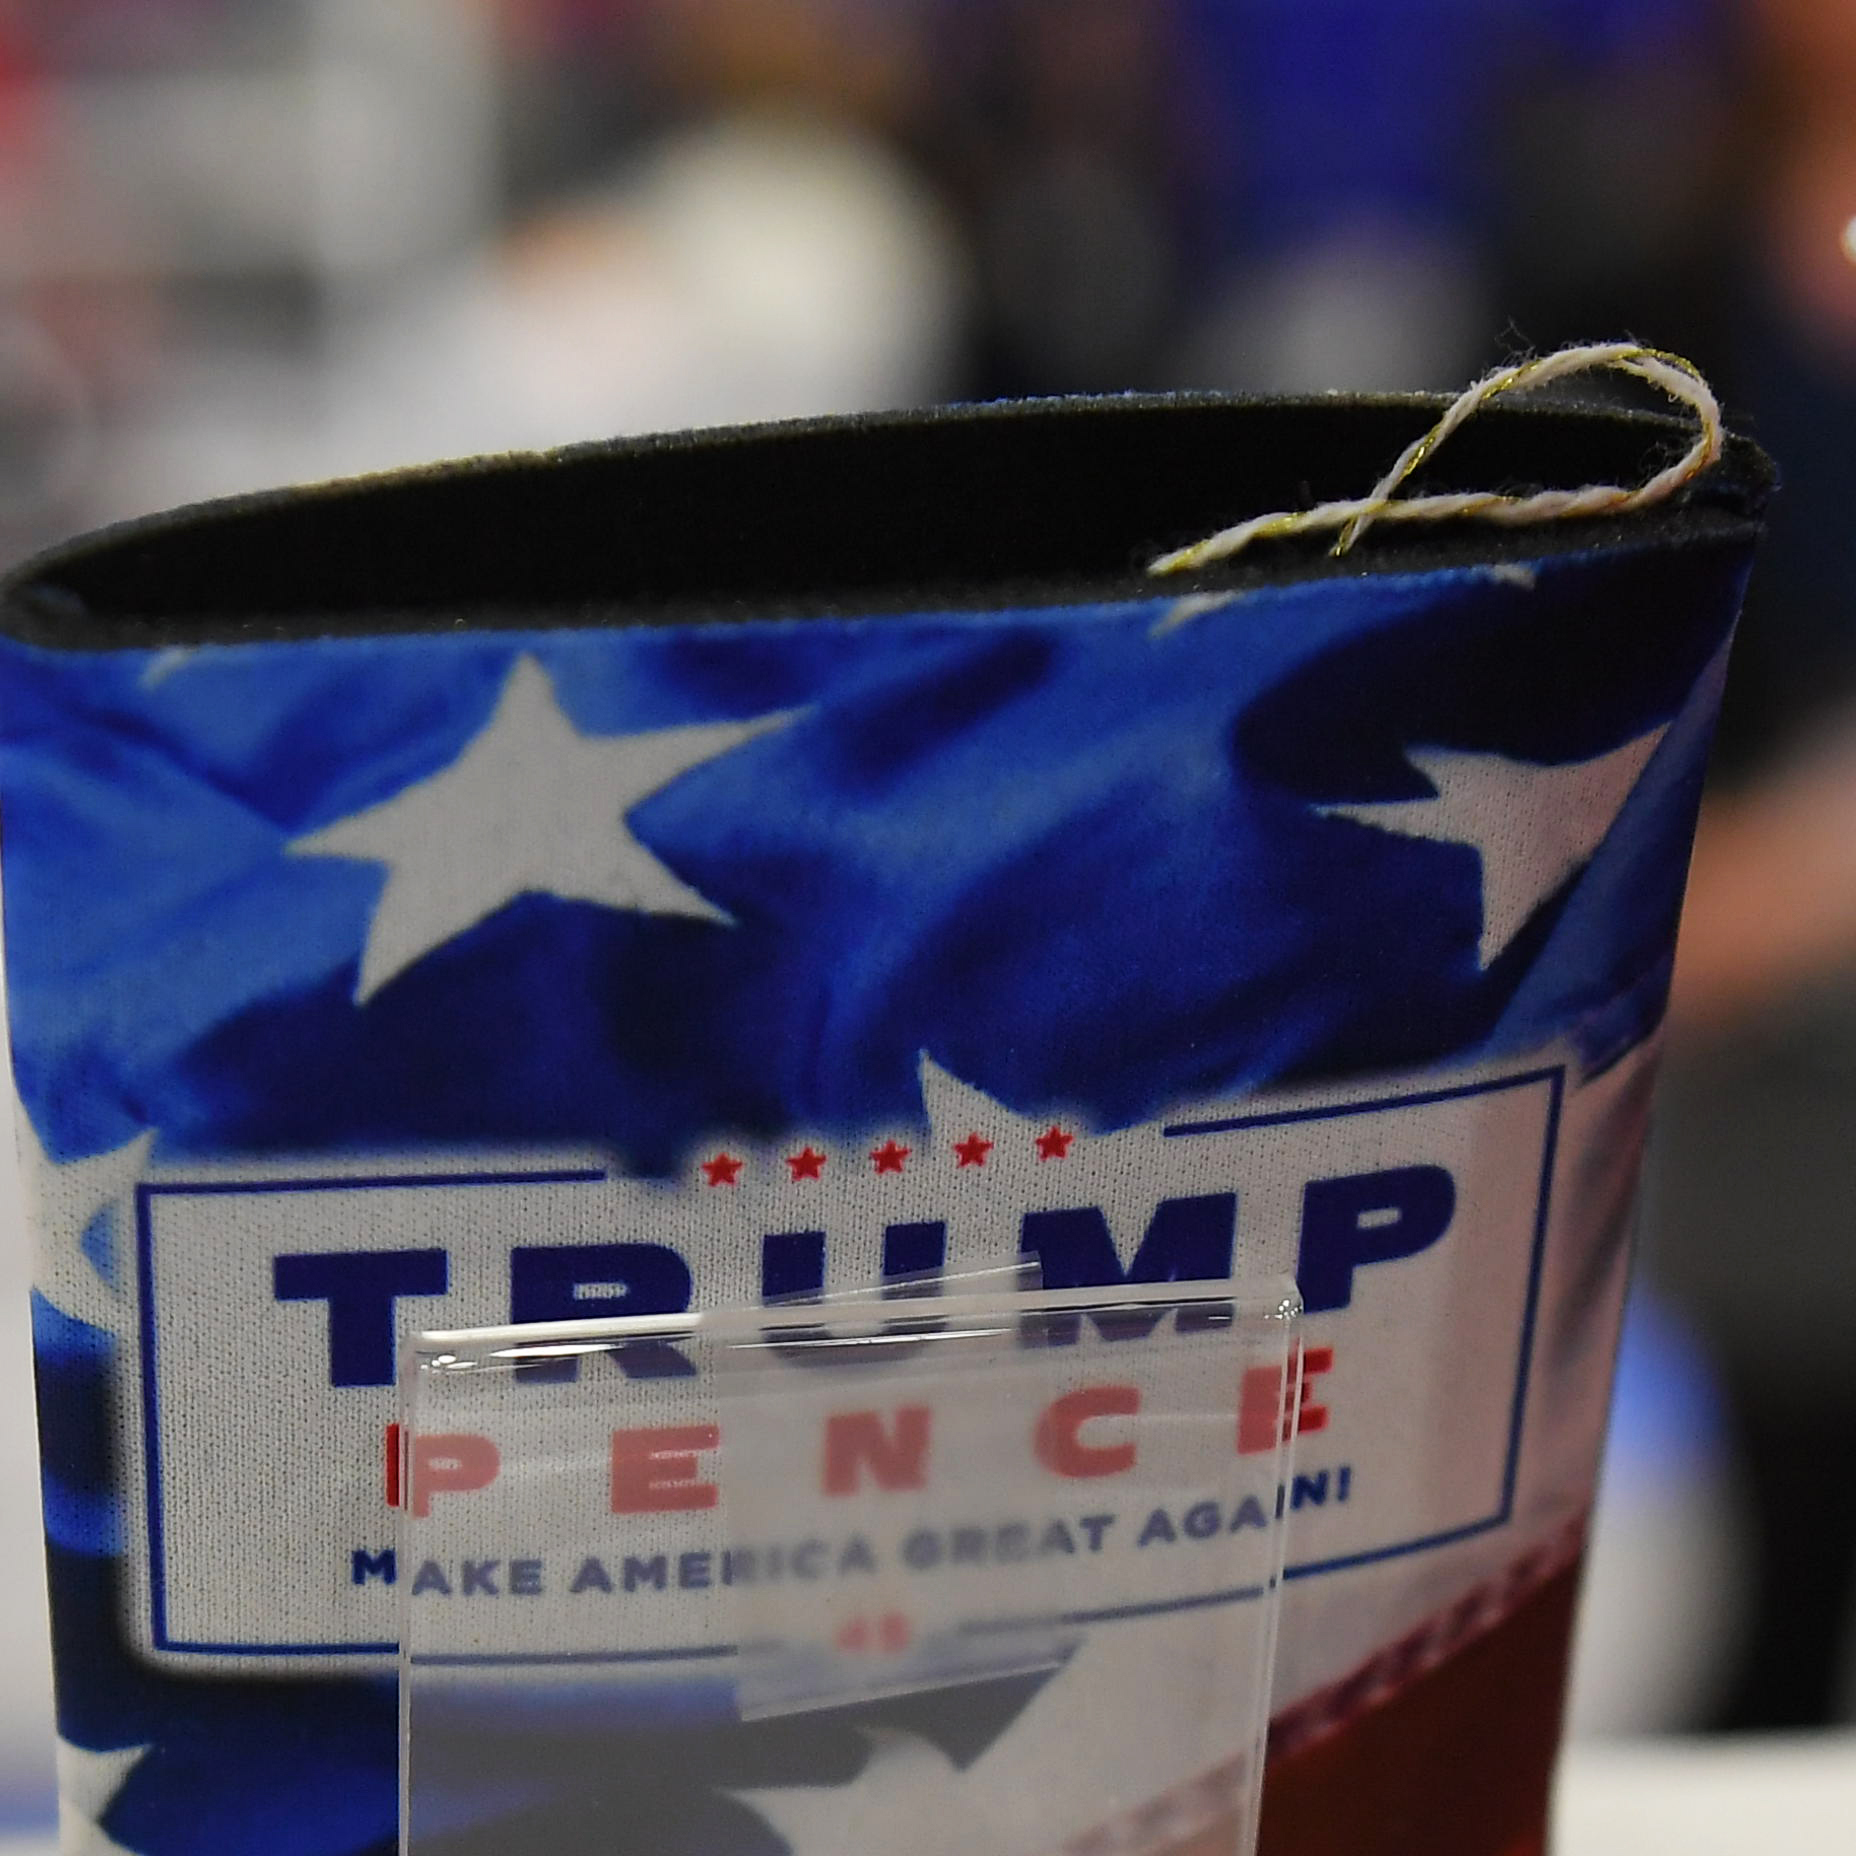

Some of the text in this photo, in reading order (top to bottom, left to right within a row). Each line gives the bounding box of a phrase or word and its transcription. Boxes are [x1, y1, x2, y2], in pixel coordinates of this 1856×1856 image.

[271, 1164, 1459, 1389] TRUMP
[385, 1346, 1333, 1521] PENCE
[350, 1549, 493, 1597] MAKE
[569, 1529, 878, 1595] AMERICA
[901, 1513, 1116, 1572] GREAT
